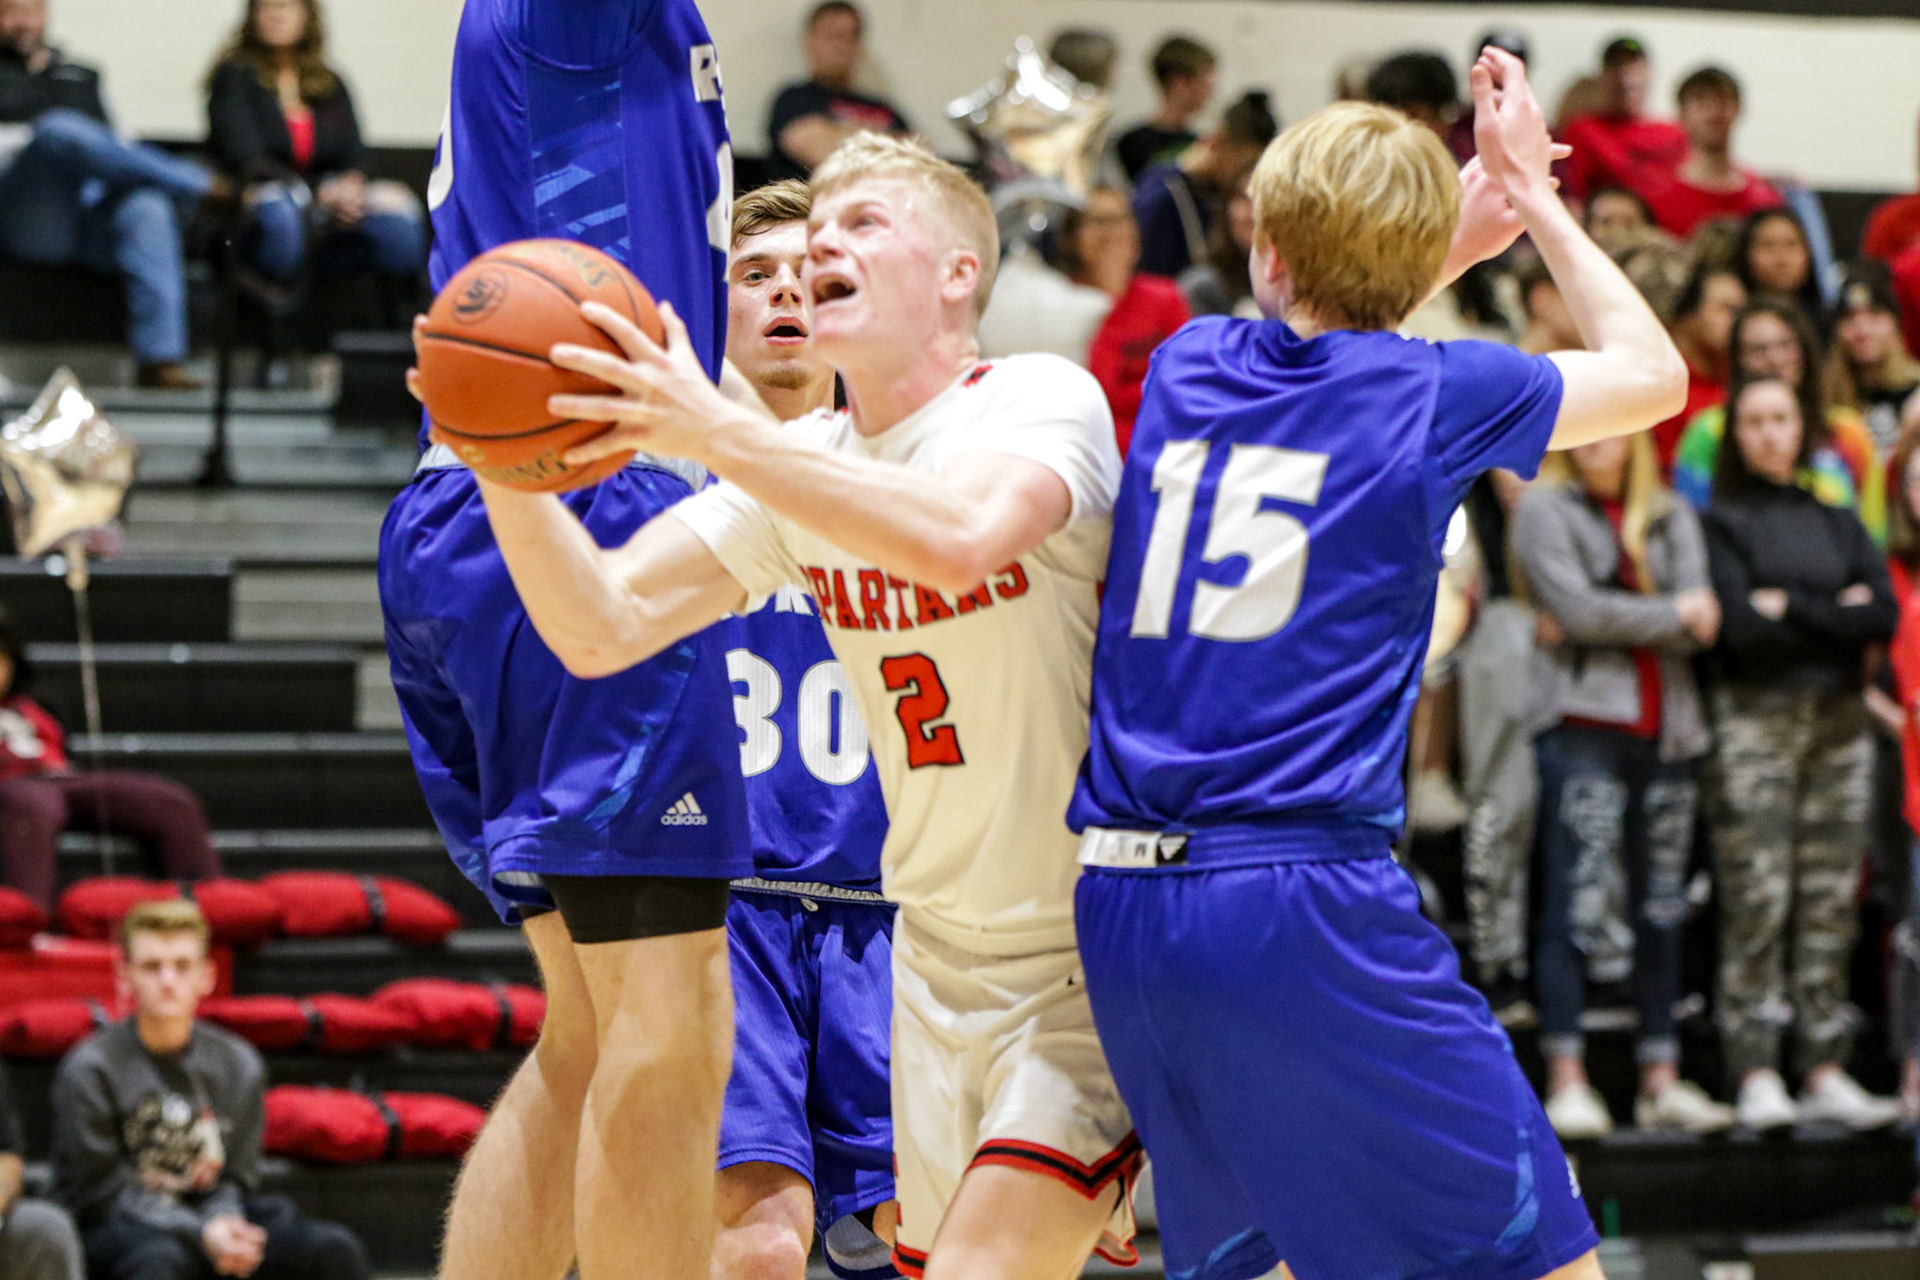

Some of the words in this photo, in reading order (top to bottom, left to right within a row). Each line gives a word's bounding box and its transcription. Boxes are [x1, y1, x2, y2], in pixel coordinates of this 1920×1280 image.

[1130, 440, 1331, 642] 15
[725, 648, 870, 786] 30
[880, 652, 966, 770] 2
[660, 812, 709, 826] adidas
